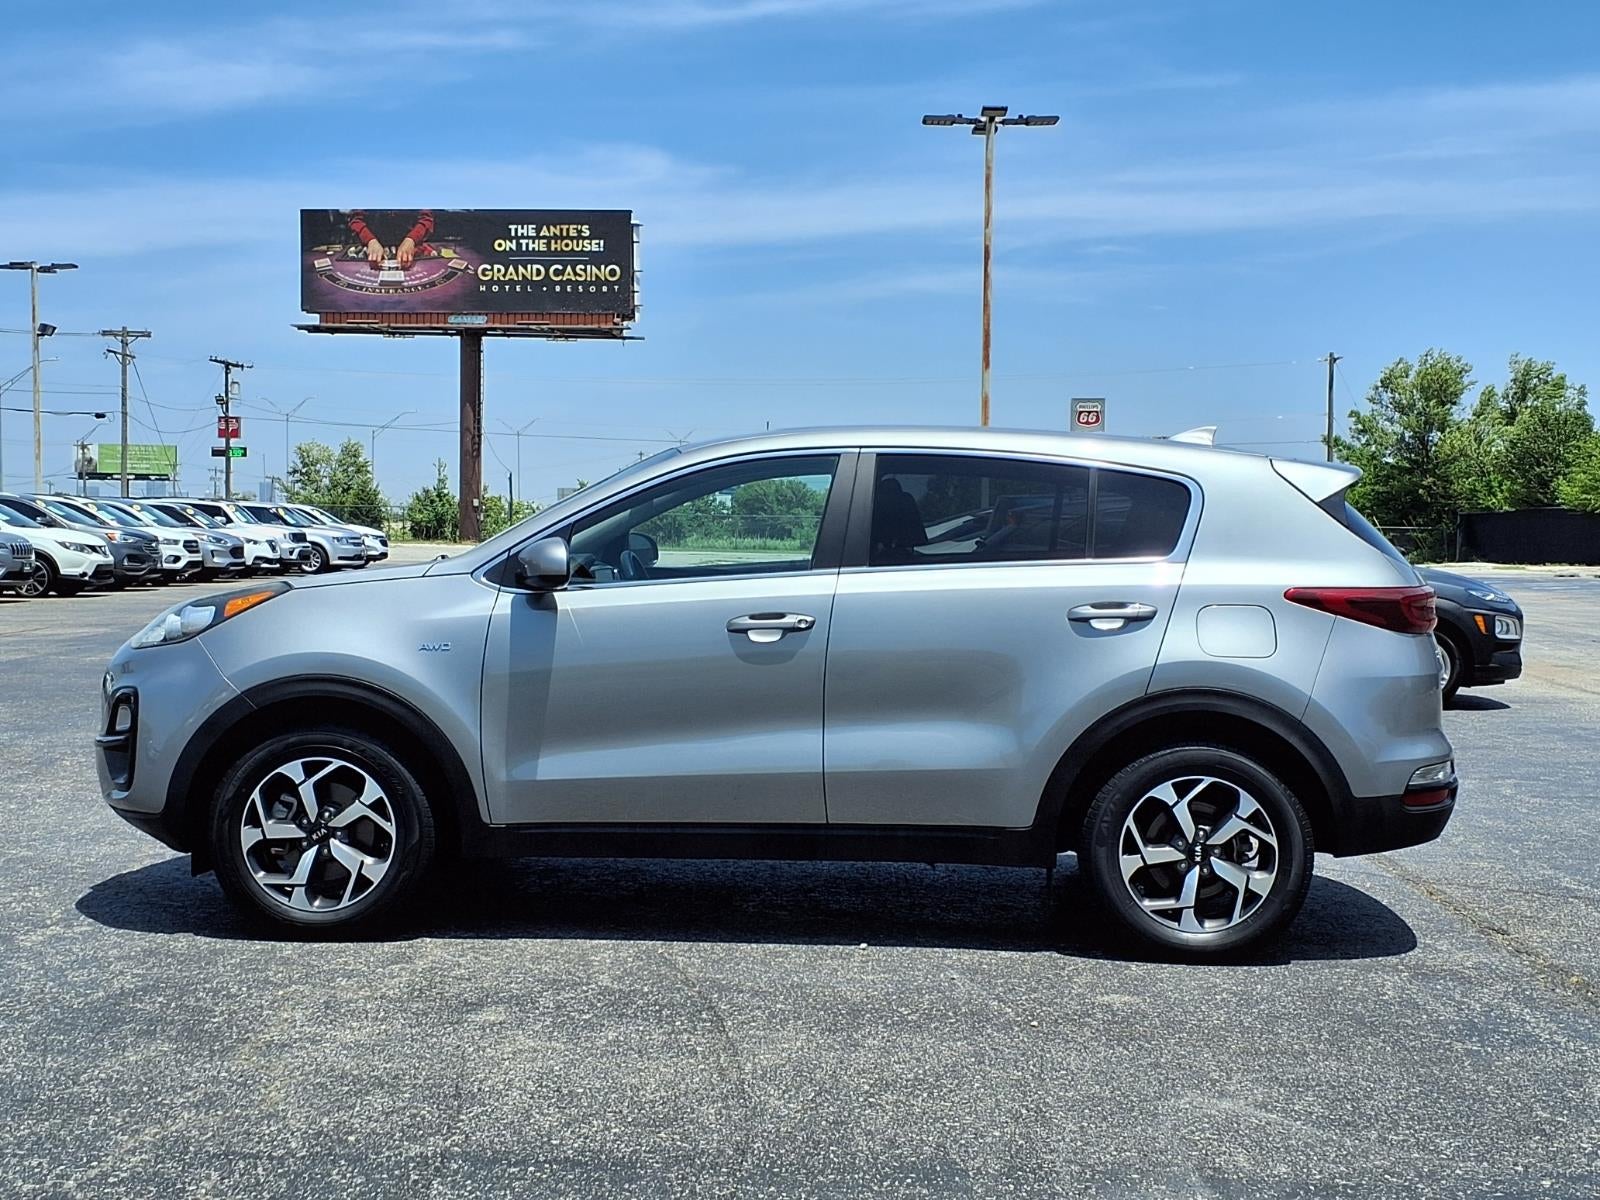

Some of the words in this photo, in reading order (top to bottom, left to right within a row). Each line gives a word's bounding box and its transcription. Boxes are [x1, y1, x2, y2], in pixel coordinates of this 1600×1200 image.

[508, 224, 537, 237] THE
[539, 224, 590, 237] ANTE'S
[493, 239, 517, 252] ON
[519, 239, 548, 252] THE
[550, 239, 604, 252] HOUSE!
[477, 264, 546, 281] GRAND
[548, 264, 621, 281] CASINO
[555, 285, 620, 293] RESORT
[1079, 412, 1098, 423] 66
[418, 643, 451, 652] AWD
[311, 828, 328, 841] KIA
[1192, 845, 1202, 862] KIA
